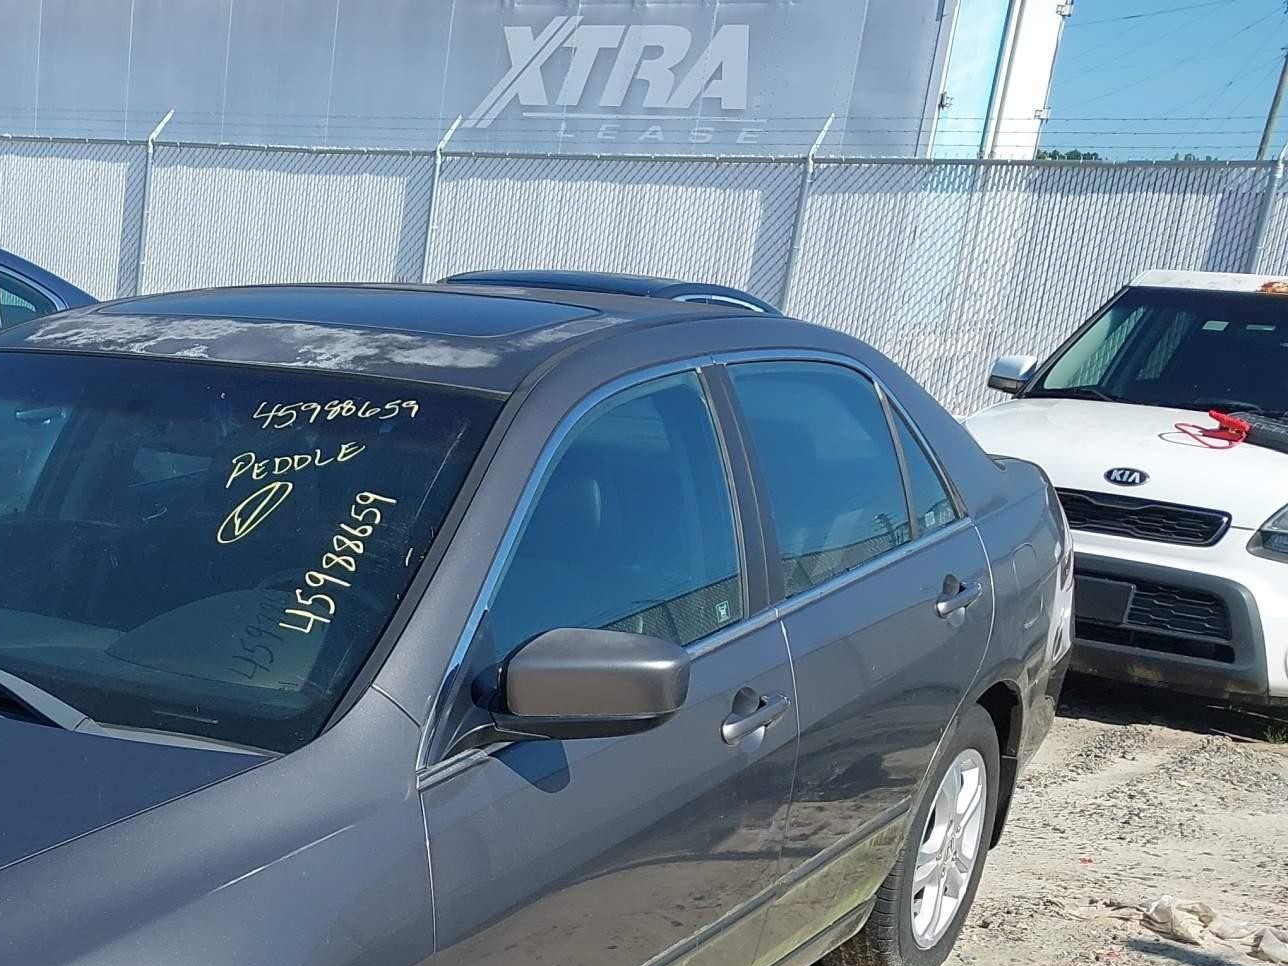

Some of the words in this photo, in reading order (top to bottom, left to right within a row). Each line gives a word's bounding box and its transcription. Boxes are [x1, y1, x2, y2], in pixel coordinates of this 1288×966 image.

[461, 15, 750, 129] XTRA
[556, 122, 768, 145] LEASE
[253, 399, 419, 428] 45988659
[225, 441, 367, 489] PEDDLE
[1110, 469, 1141, 484] KIA
[278, 491, 398, 634] 45988659
